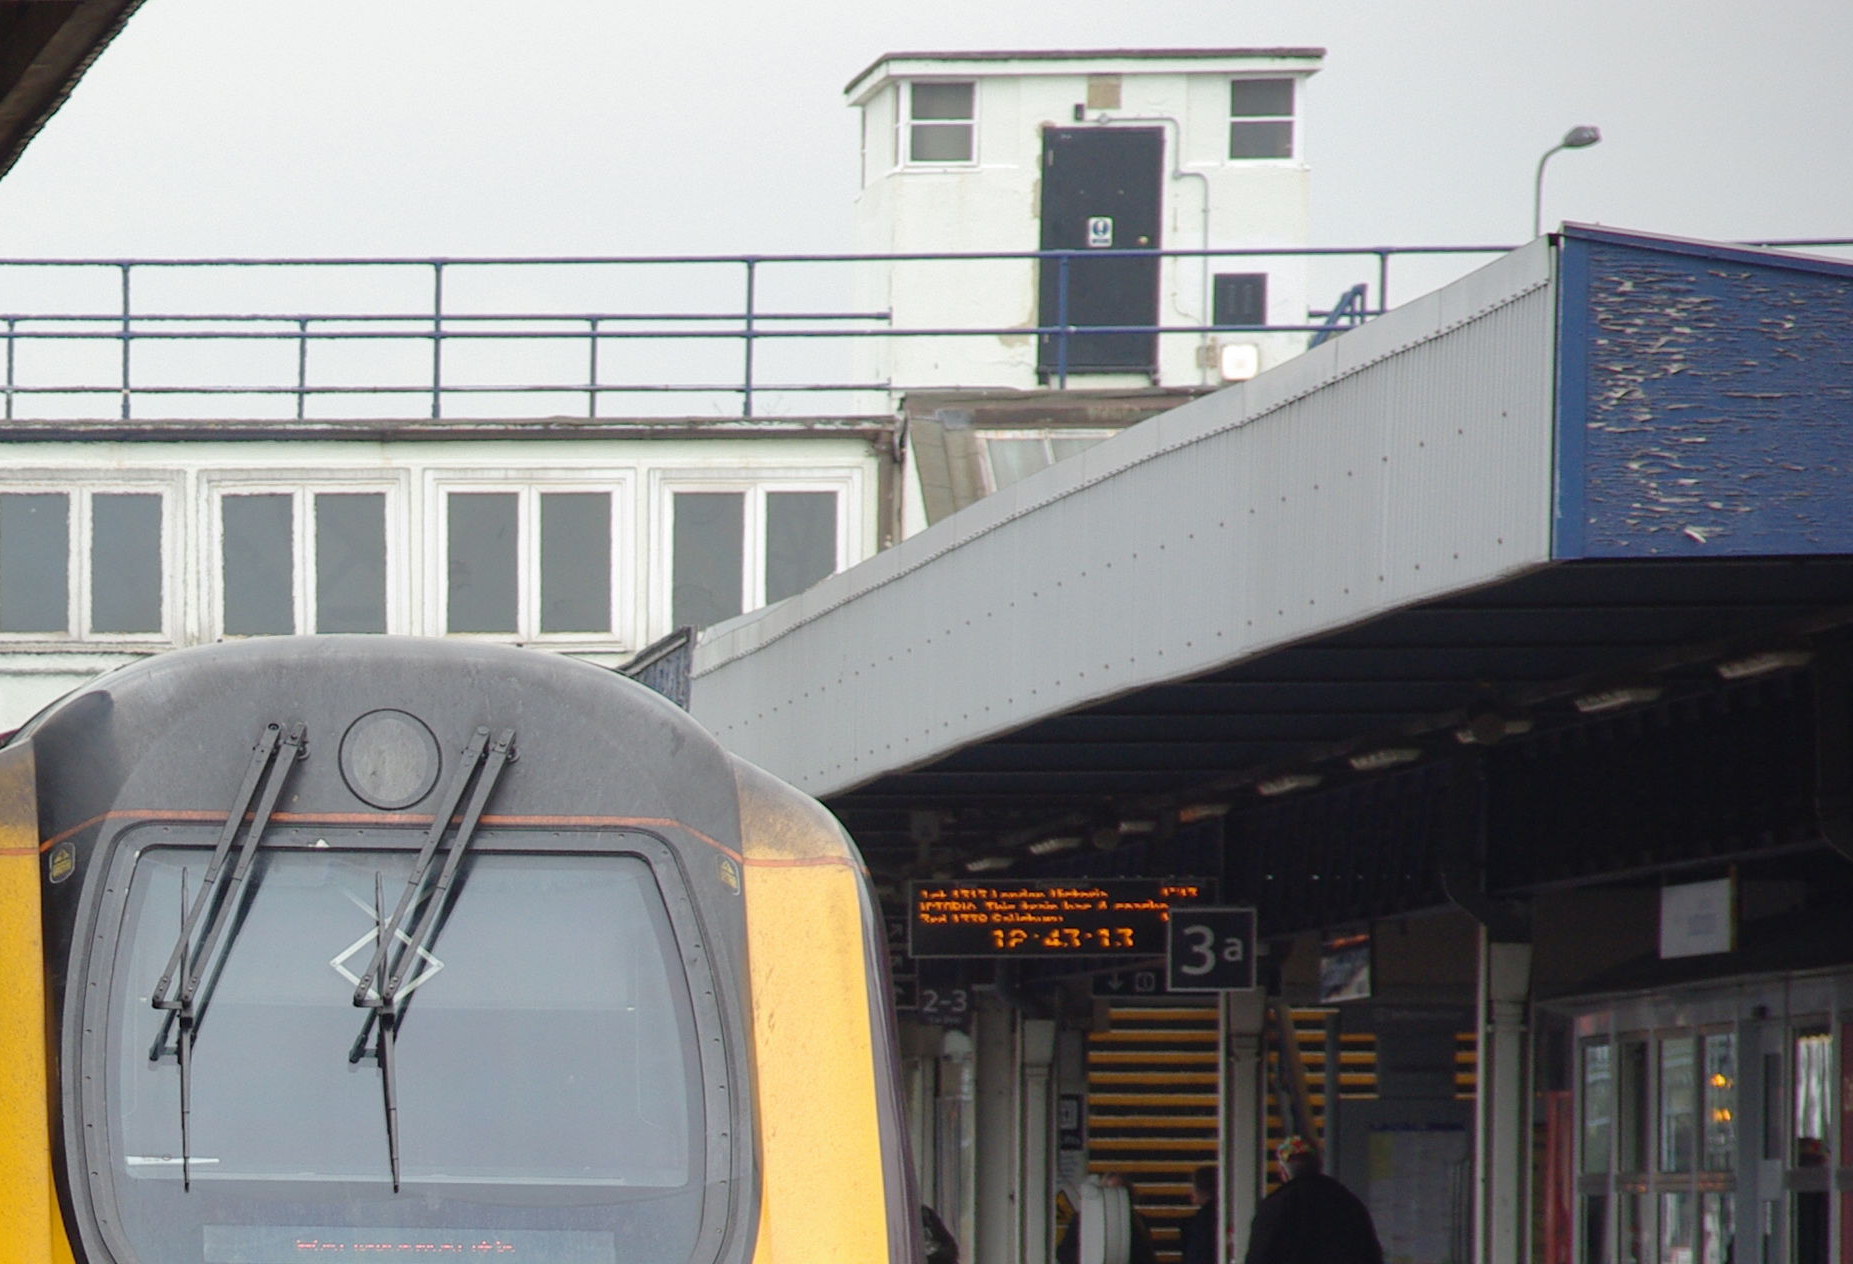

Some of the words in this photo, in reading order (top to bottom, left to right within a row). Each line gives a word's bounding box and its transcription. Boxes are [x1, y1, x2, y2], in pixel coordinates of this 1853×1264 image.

[1180, 923, 1217, 977] 3
[1223, 936, 1245, 962] a
[922, 988, 967, 1013] 2-3
